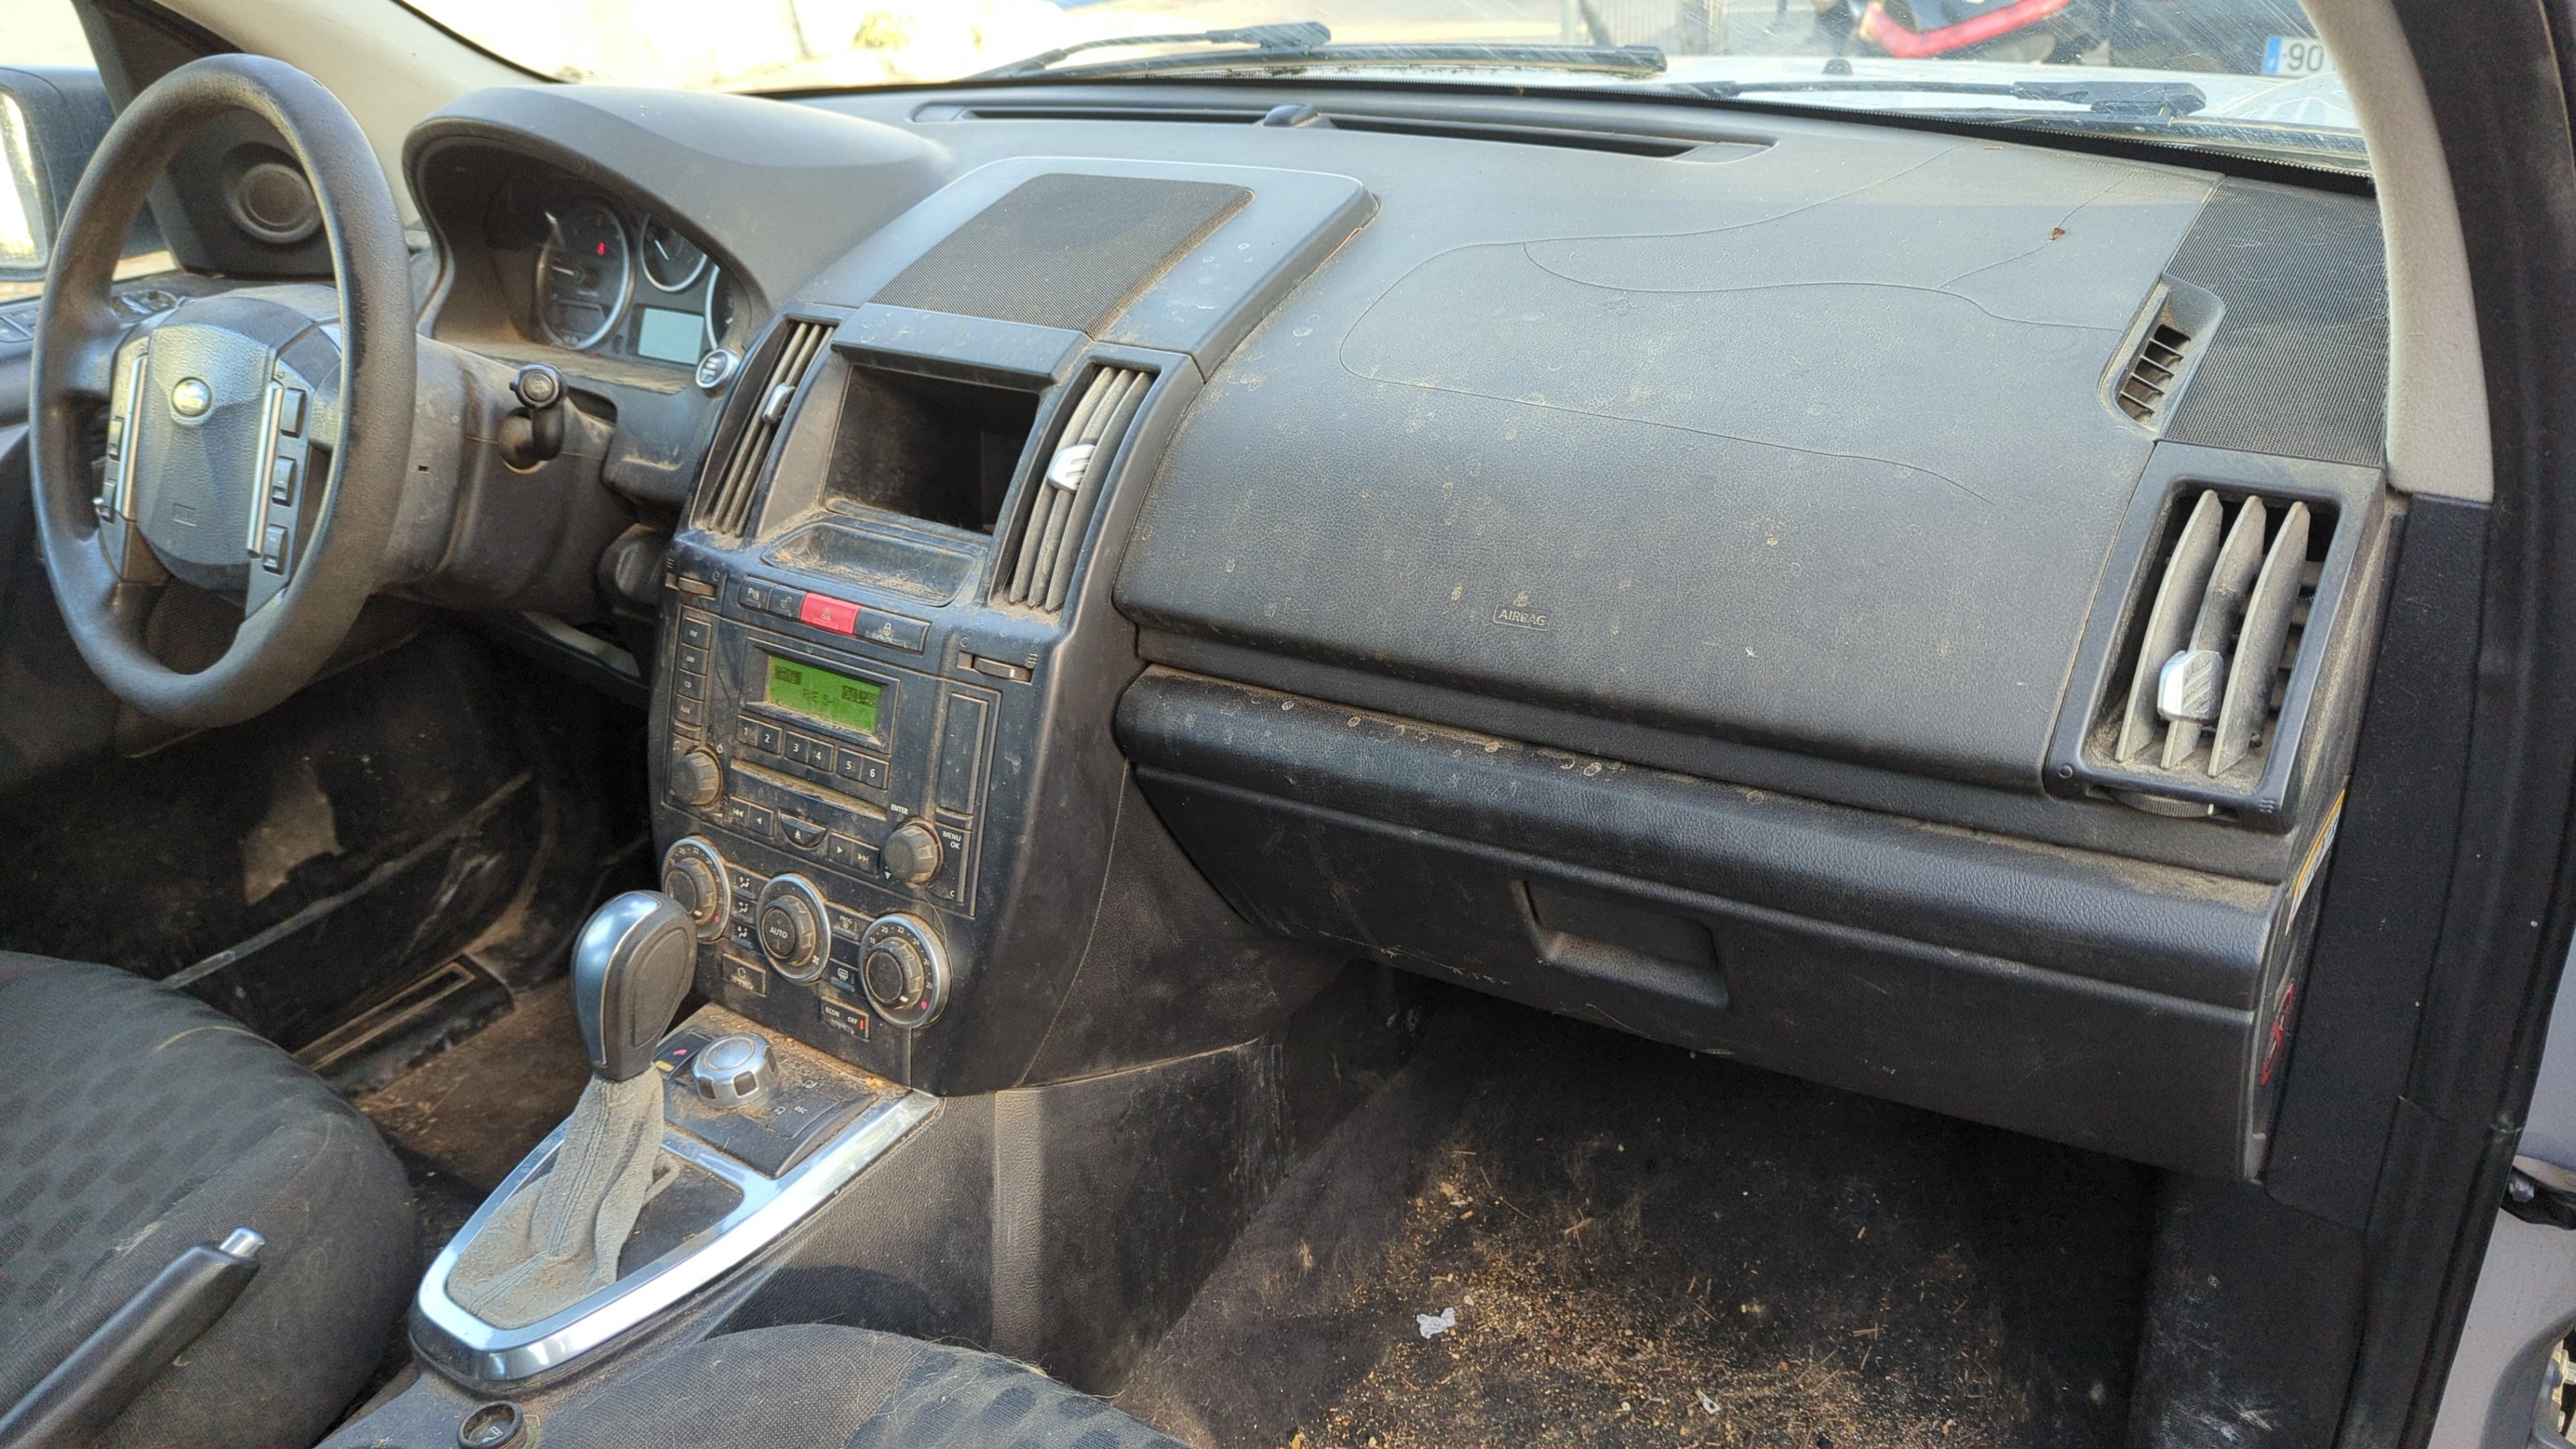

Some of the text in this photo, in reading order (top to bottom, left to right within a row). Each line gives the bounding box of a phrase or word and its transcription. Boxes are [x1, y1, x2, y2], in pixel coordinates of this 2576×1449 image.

[1498, 609, 1547, 626] AIRBAG
[686, 655, 695, 663] AM
[680, 706, 690, 714] AUX
[743, 727, 748, 735] 1
[765, 734, 770, 743] 2
[794, 744, 799, 752] 3
[815, 752, 821, 761] 4
[847, 761, 852, 769] 5
[870, 769, 875, 777] 6
[891, 804, 908, 815] ENTER
[943, 831, 961, 841] MENU
[950, 841, 961, 850] OK
[840, 915, 853, 925] PROG
[769, 926, 788, 938] AUTO
[881, 926, 888, 934] 20
[897, 926, 905, 934] 22
[869, 936, 876, 945] 18
[913, 938, 920, 946] 24
[825, 1007, 858, 1025] ECON OFF
[794, 1106, 808, 1114] DSC
